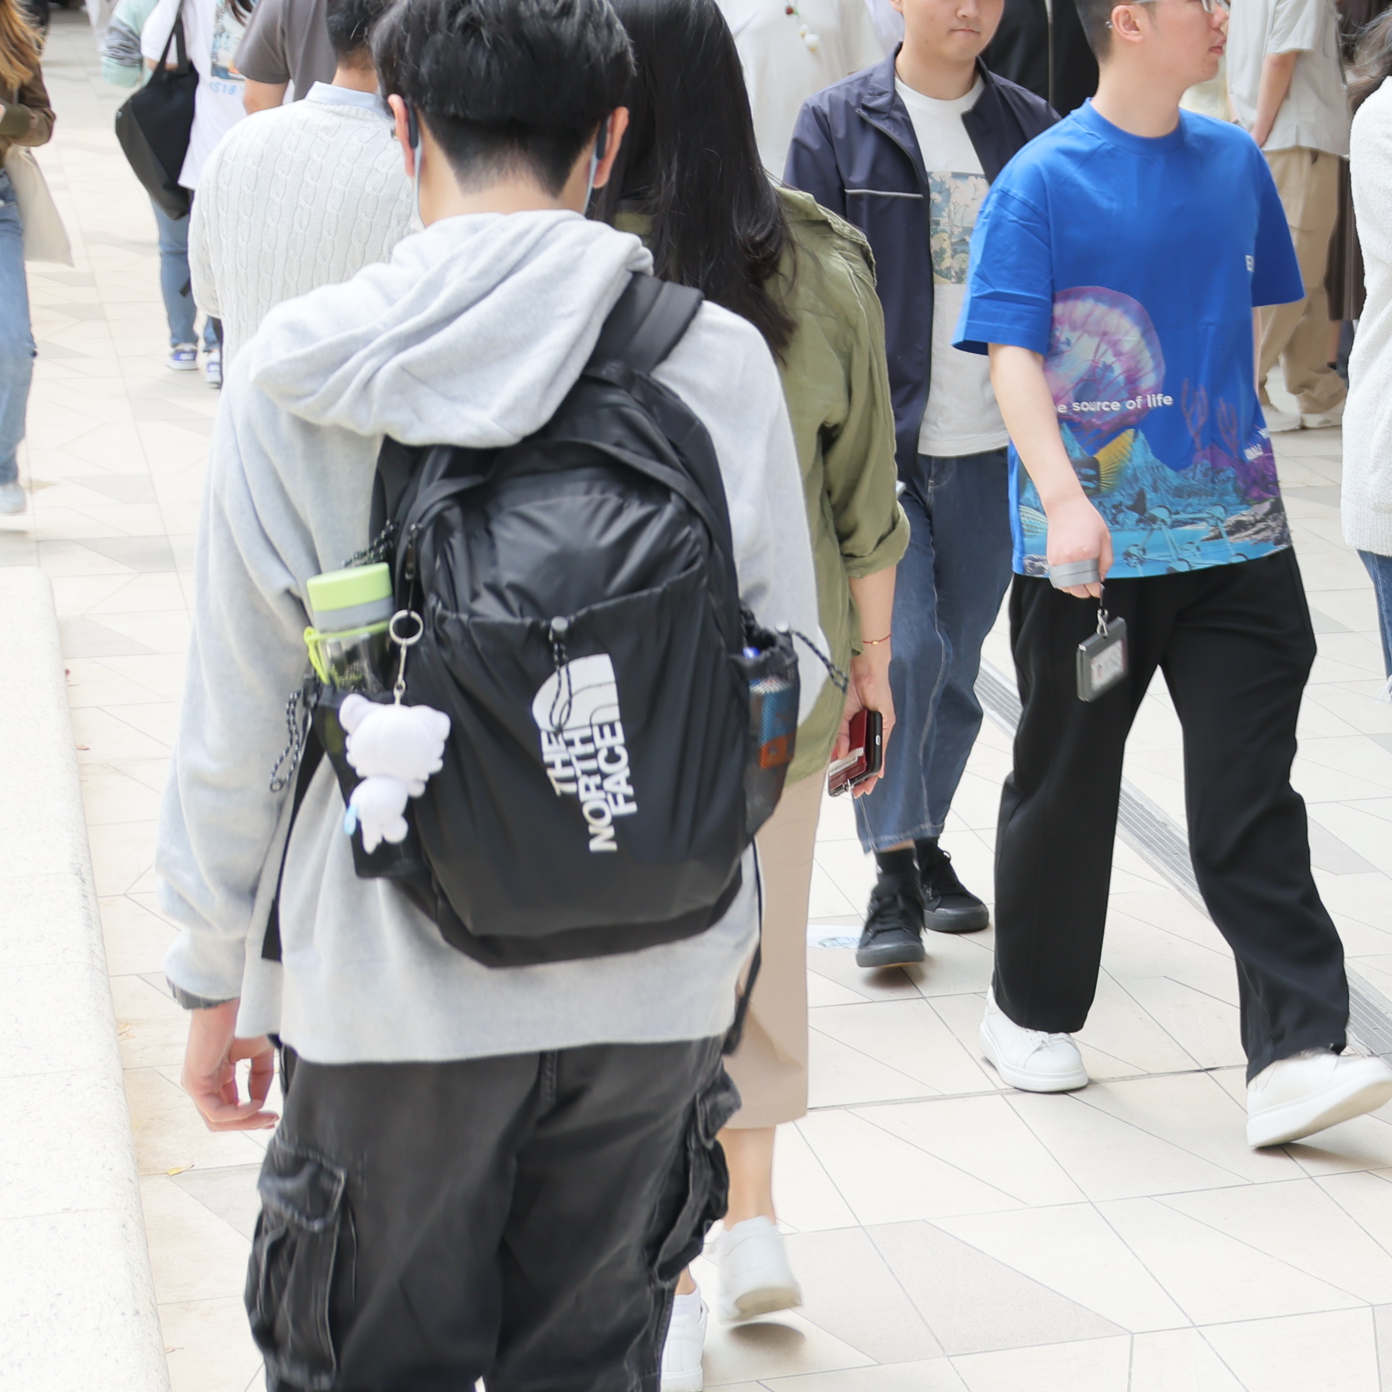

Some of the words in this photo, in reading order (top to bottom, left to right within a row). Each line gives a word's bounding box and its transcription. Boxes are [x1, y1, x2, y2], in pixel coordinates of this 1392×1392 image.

[1072, 400, 1121, 412] source
[1125, 395, 1142, 410] of
[1146, 393, 1174, 408] life
[540, 729, 578, 797] THE
[562, 725, 618, 852] NORTH
[592, 720, 638, 816] FACE
